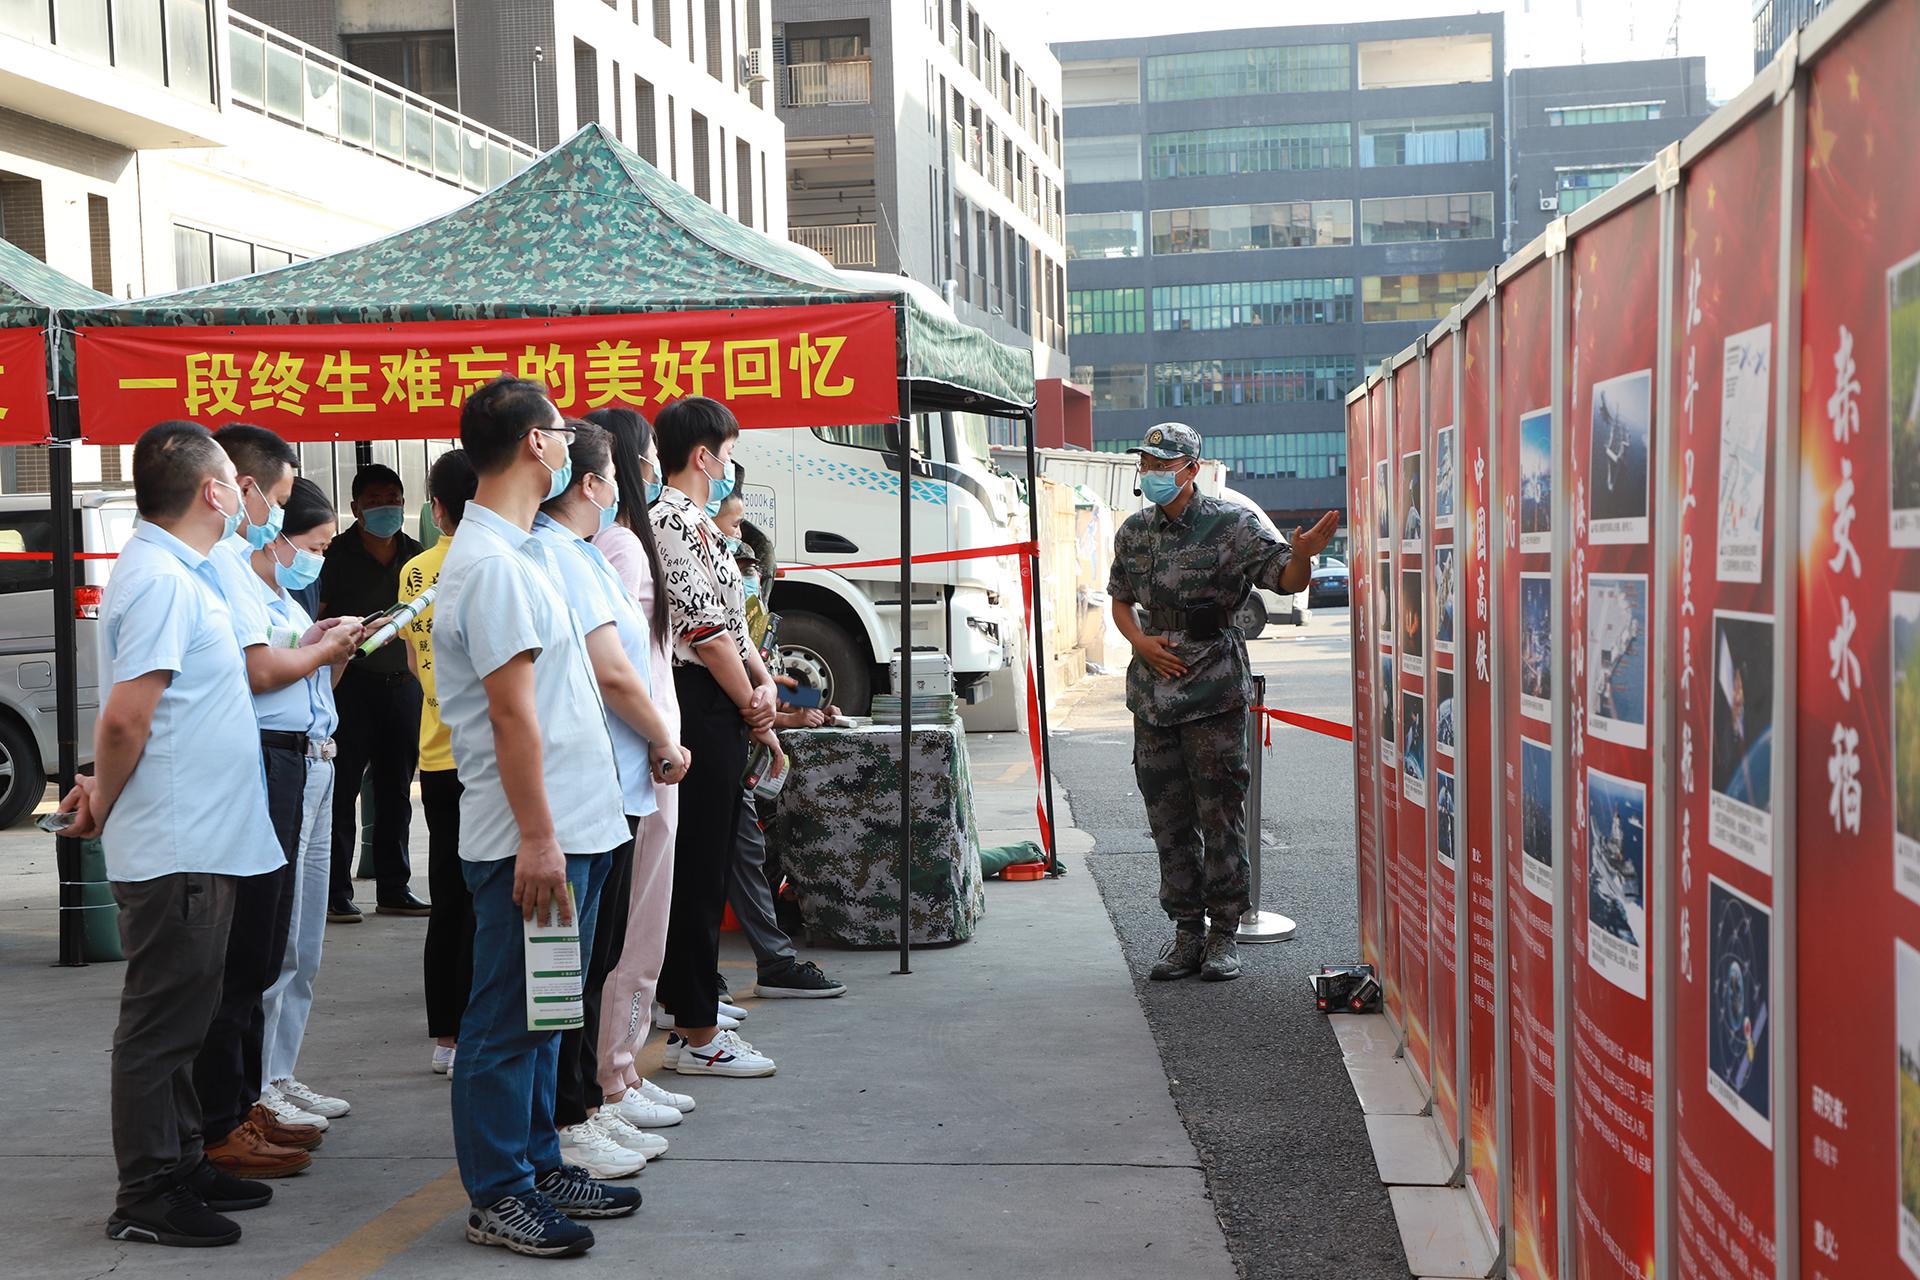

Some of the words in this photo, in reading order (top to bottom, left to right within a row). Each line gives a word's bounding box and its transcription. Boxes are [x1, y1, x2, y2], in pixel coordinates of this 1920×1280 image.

[119, 333, 853, 416] 一段终生难忘的美好回忆
[742, 493, 774, 510] 5000kg
[1474, 447, 1490, 683] 中国高铁
